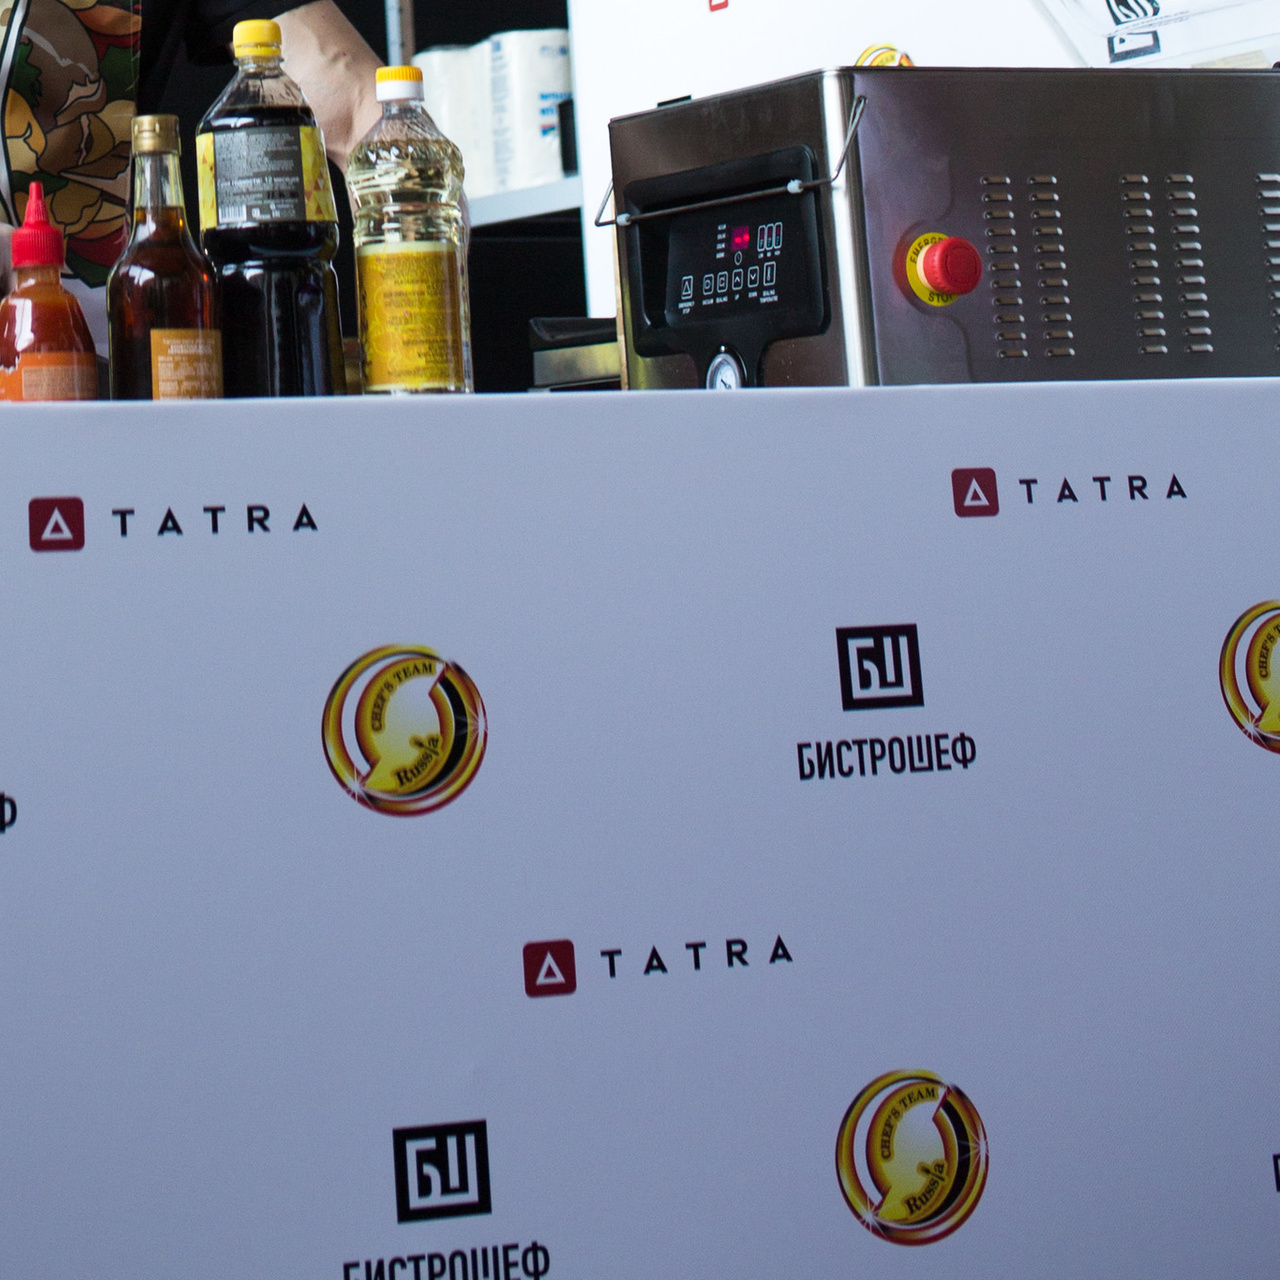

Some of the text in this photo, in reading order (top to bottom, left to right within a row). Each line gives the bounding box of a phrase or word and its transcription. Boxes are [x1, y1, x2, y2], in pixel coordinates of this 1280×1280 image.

[1018, 473, 1188, 504] TATRA
[111, 503, 318, 537] TATRA
[392, 663, 433, 683] TEAM
[796, 731, 977, 781] БИСТРОШЕФ
[600, 934, 793, 979] TATRA
[898, 1087, 936, 1108] TEAM
